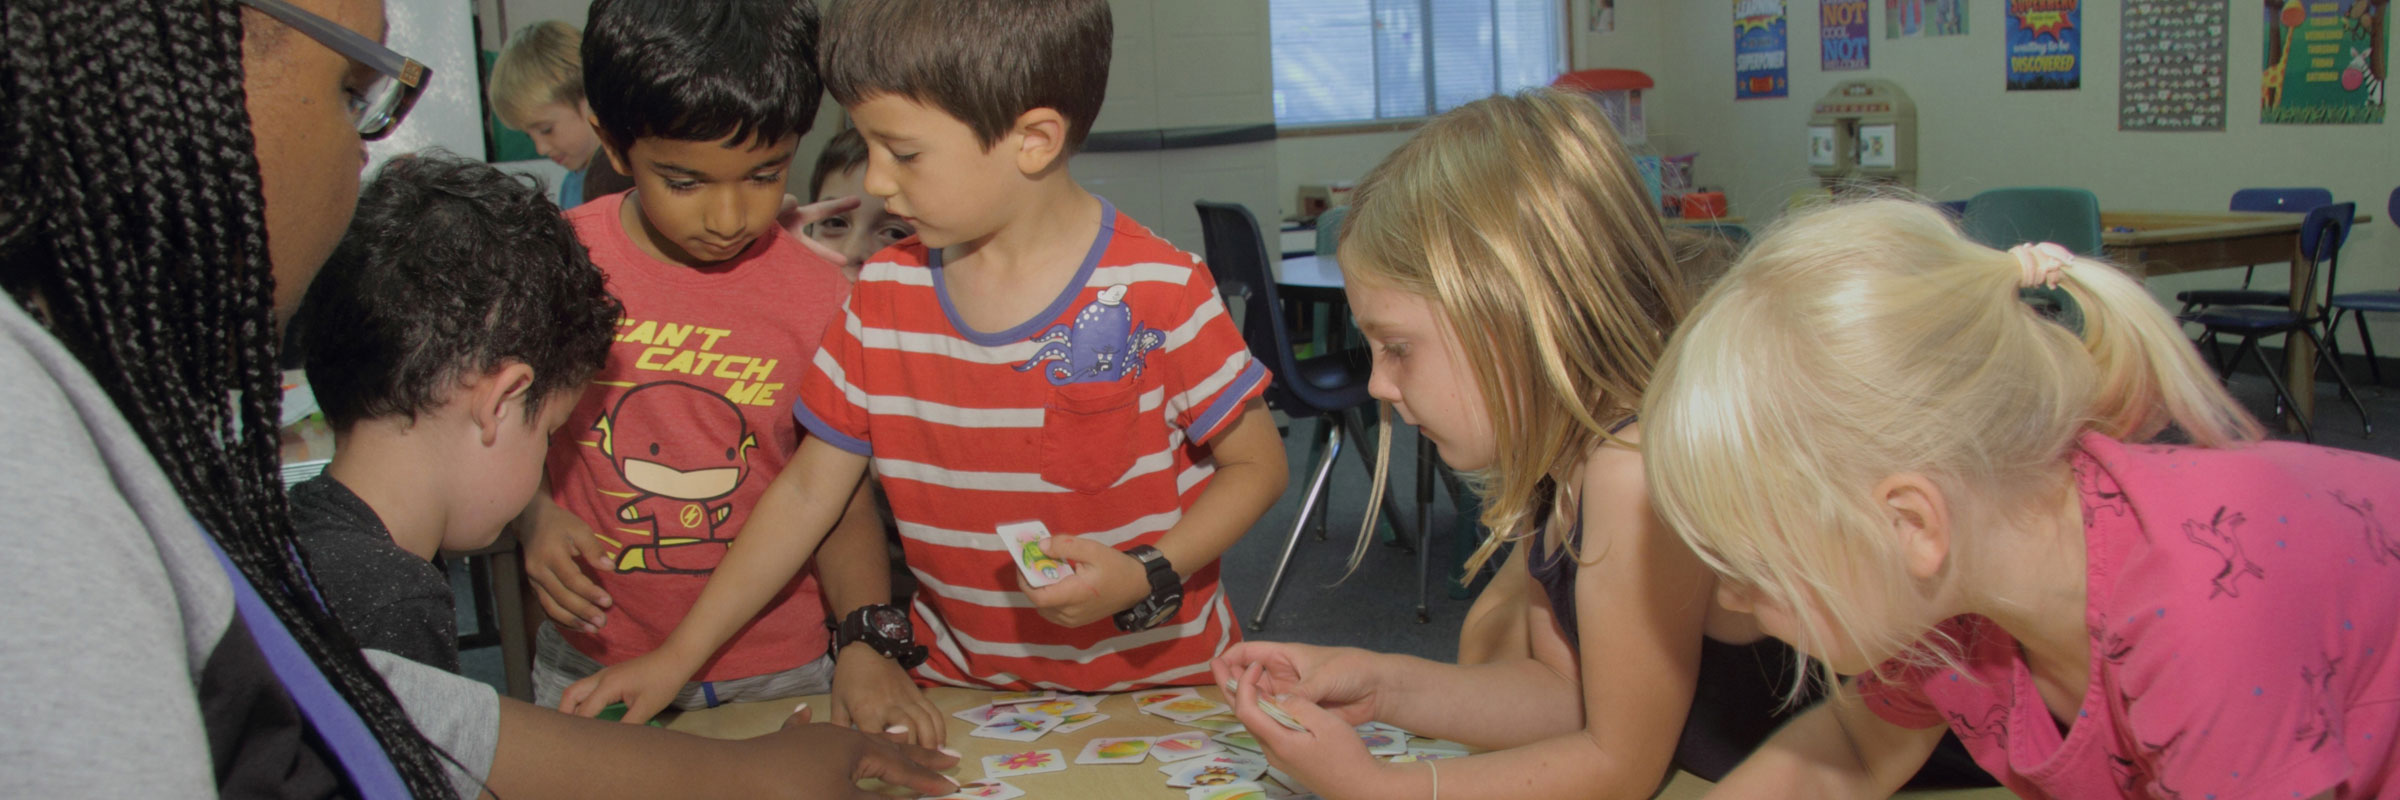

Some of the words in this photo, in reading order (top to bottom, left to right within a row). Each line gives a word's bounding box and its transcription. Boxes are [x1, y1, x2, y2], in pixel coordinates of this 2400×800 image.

[1823, 2, 1867, 26] NOT
[1823, 36, 1868, 61] NOT
[1736, 50, 1785, 72] SUPERPOWER
[2011, 54, 2075, 73] DISCOVERED
[635, 346, 778, 382] CATCH
[724, 380, 785, 406] ME
